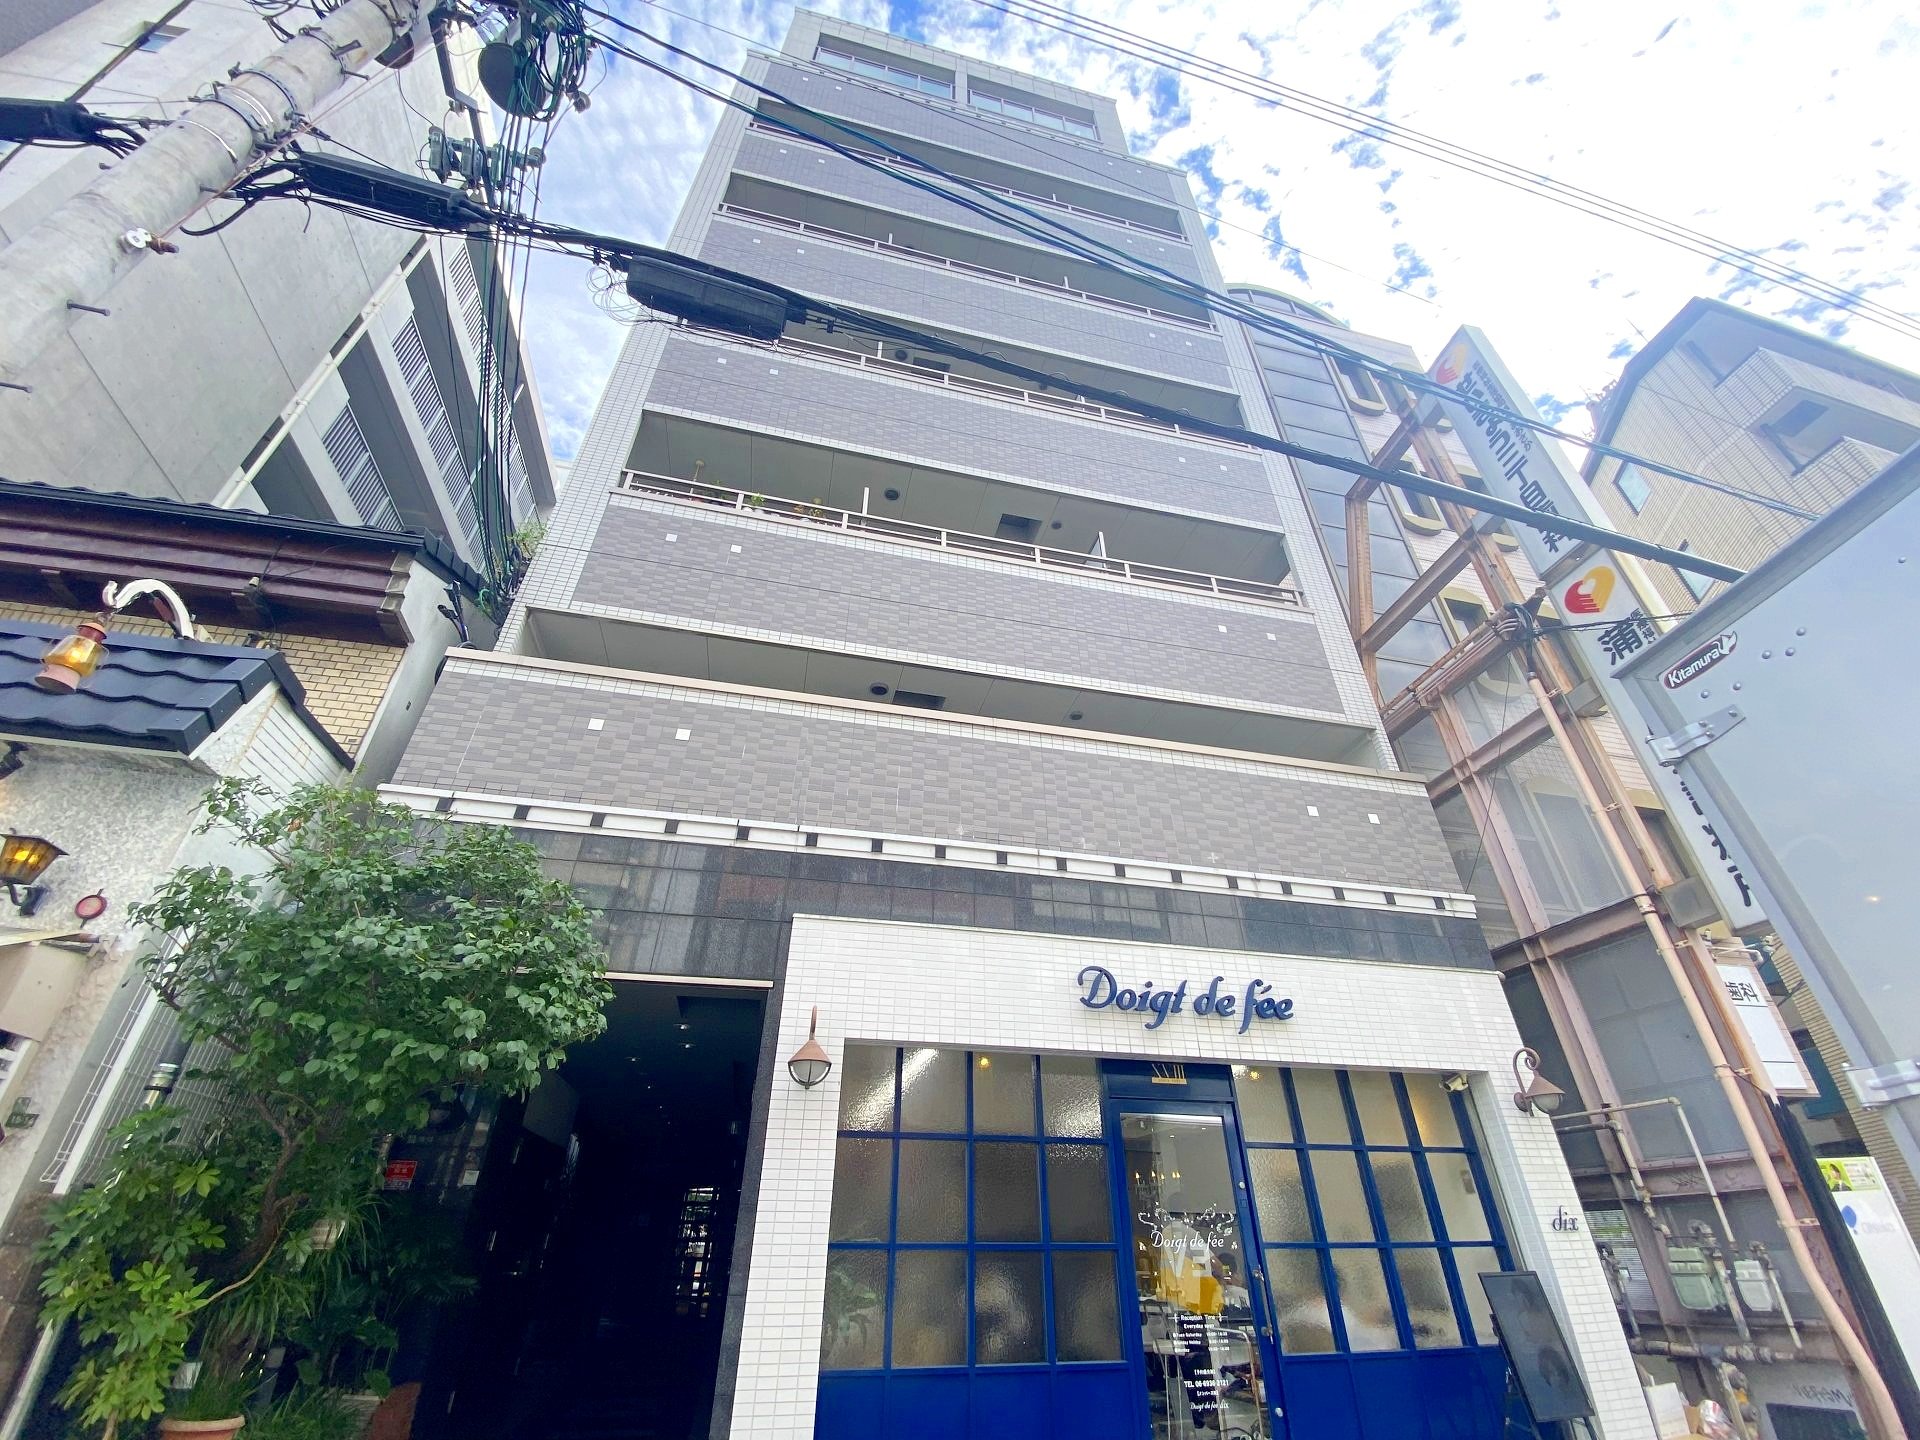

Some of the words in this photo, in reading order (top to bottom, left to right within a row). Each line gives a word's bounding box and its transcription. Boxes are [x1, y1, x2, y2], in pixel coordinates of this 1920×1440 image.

[1668, 648, 1720, 688] Kitamura
[1078, 966, 1188, 1030] Doigt
[1193, 976, 1236, 1016] de
[1238, 979, 1294, 1034] fée
[1552, 1205, 1579, 1231] dix
[1151, 1230, 1187, 1254] Doigt
[1190, 1231, 1204, 1248] de
[1206, 1231, 1224, 1254] fée
